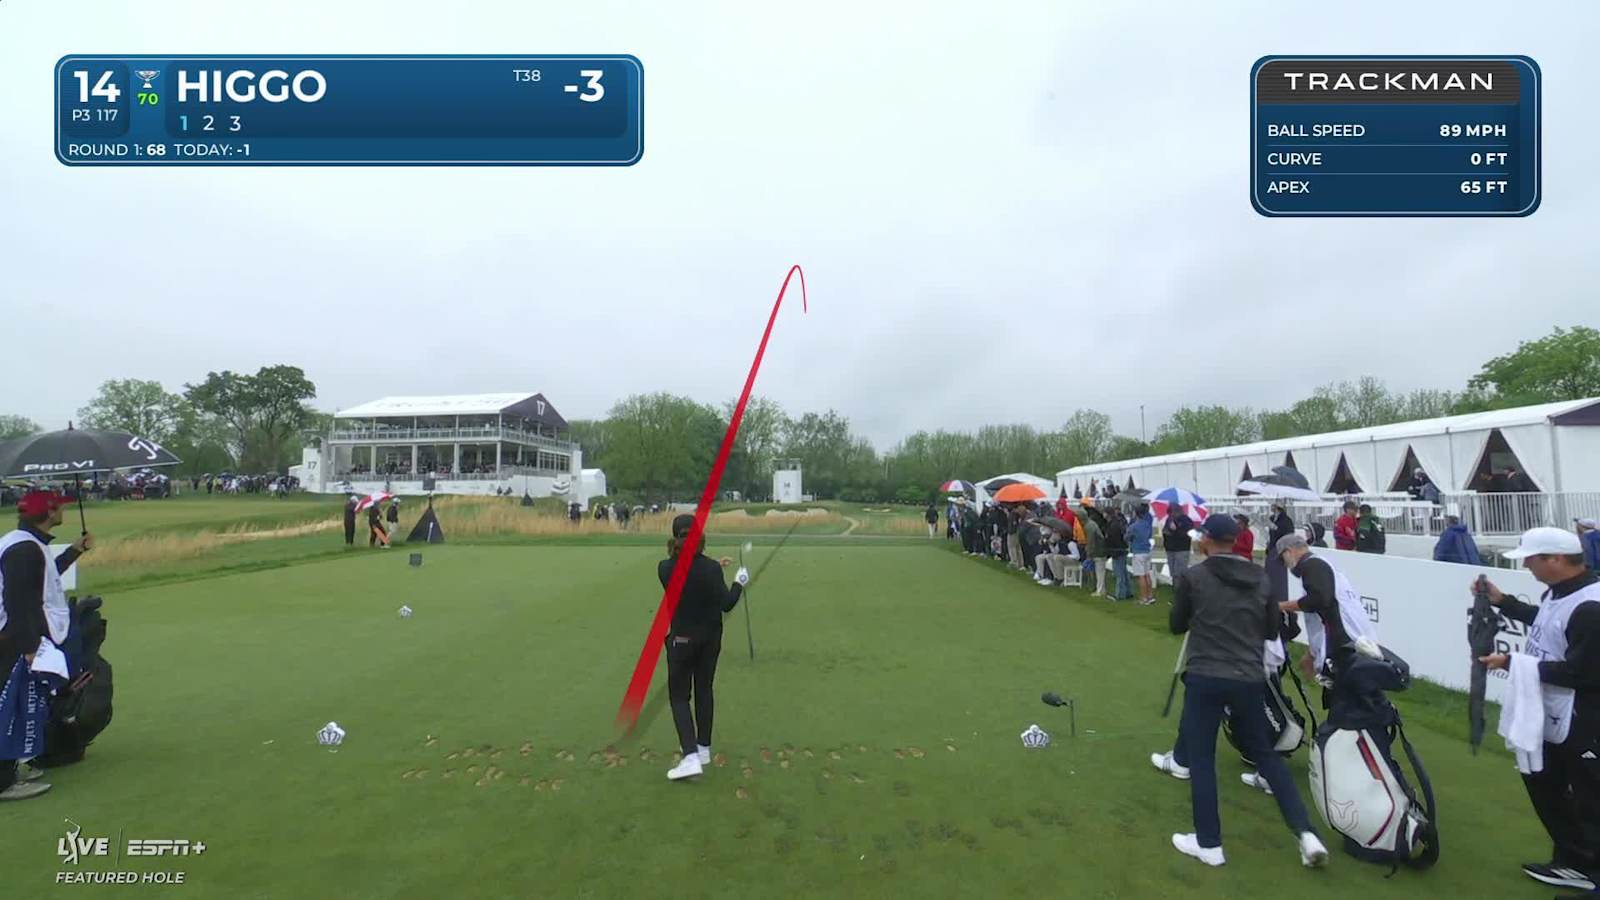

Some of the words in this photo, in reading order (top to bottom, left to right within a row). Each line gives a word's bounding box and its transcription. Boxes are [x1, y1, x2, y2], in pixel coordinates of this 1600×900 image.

[536, 400, 546, 416] 17
[24, 462, 69, 472] PRO
[72, 459, 94, 469] V1
[24, 720, 36, 754] NETJETS
